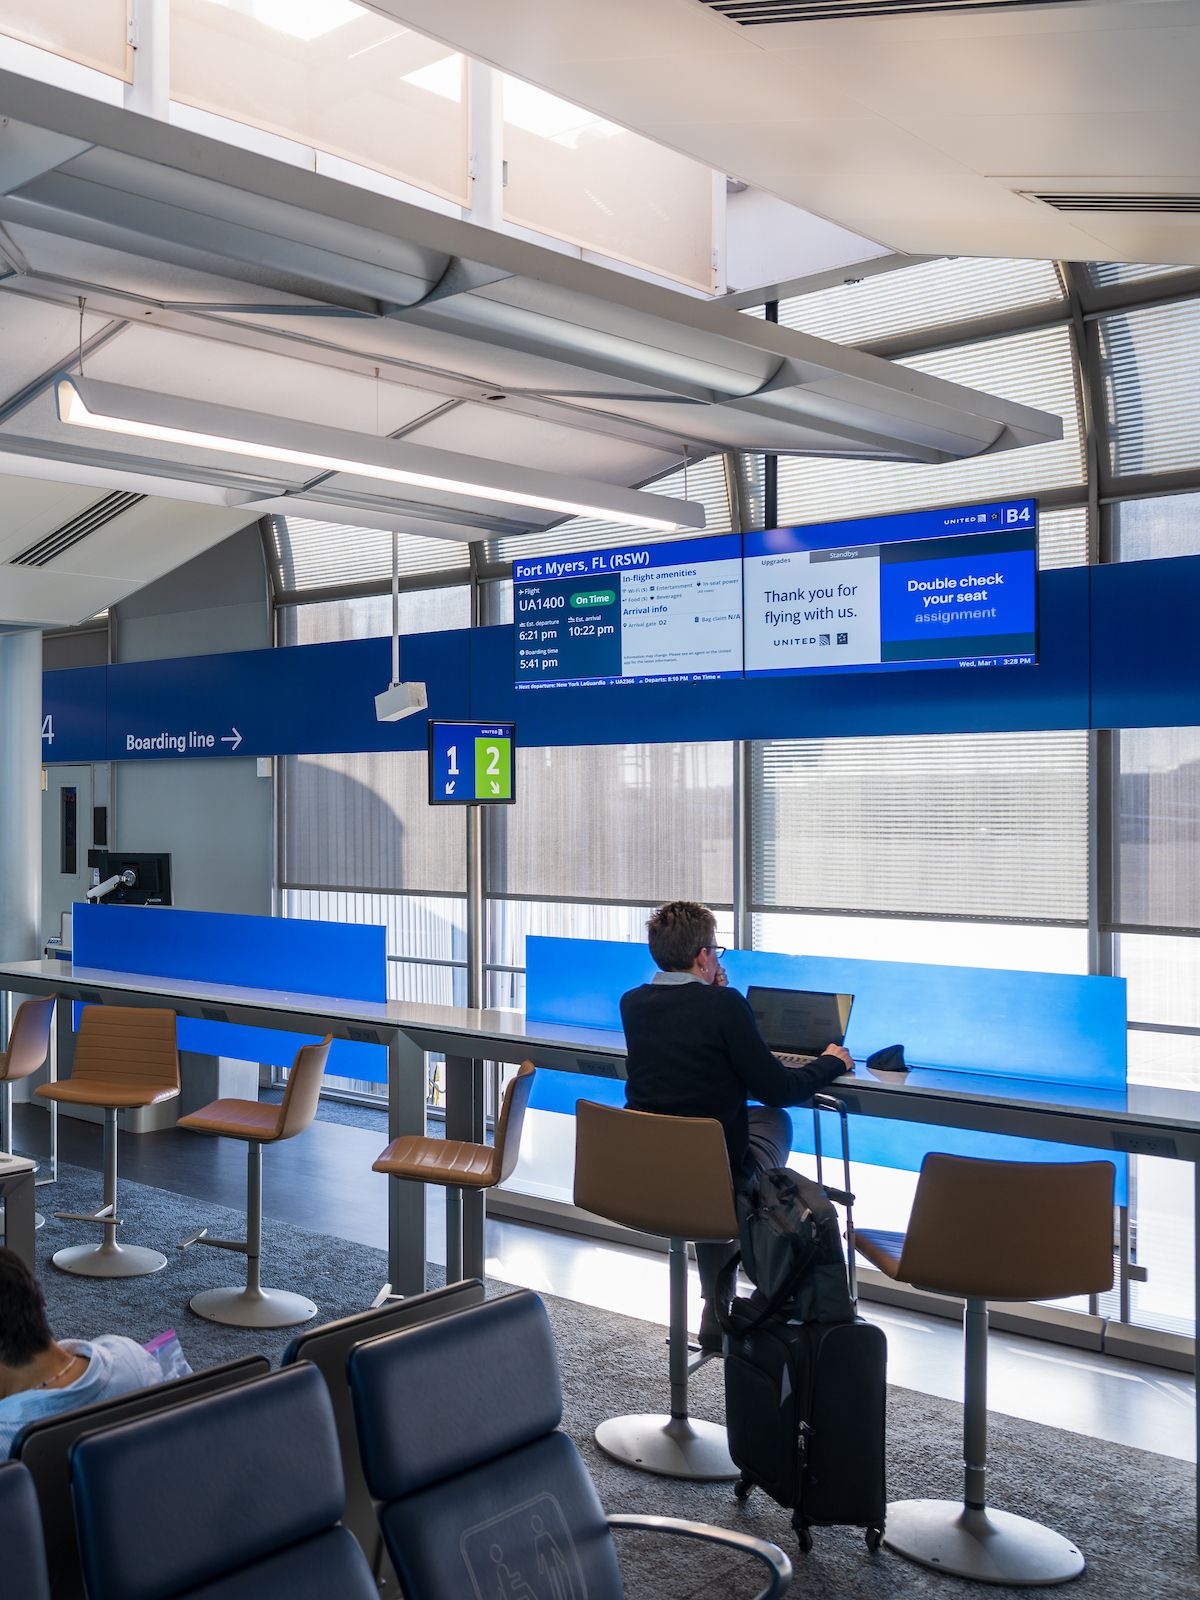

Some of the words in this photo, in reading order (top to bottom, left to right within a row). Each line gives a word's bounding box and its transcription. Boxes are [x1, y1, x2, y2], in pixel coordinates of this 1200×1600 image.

[943, 516, 976, 525] UNITED
[1006, 507, 1030, 523] B4
[829, 550, 859, 559] Standbys
[516, 565, 542, 578] Fort
[545, 560, 588, 577] Myers,
[592, 556, 607, 569] FL
[610, 551, 650, 569] (RSW)
[761, 558, 791, 566] Upgrades
[623, 573, 654, 583] In-flight
[656, 569, 697, 579] amenities
[657, 583, 693, 591] Entertainment
[907, 577, 957, 592] Double
[959, 573, 1004, 588] check
[524, 587, 540, 596] Flight
[764, 587, 805, 603] Thank
[808, 588, 834, 603] you
[837, 583, 858, 597] for
[519, 596, 565, 611] UA1400
[575, 597, 588, 605] On
[589, 594, 610, 603] Time
[922, 592, 954, 608] your
[956, 590, 988, 603] seat
[623, 606, 650, 615] Arrival
[652, 605, 668, 613] info
[915, 607, 997, 624] assignment
[765, 610, 801, 627] flying
[804, 606, 834, 621] with
[838, 607, 857, 618] us.
[535, 619, 560, 627] departure
[519, 630, 538, 641] 6:21
[541, 630, 557, 641] pm
[568, 625, 595, 637] 10:22
[597, 625, 614, 637] pm
[773, 637, 816, 646] UNITED
[520, 658, 539, 669] 5:41
[542, 659, 558, 670] pm
[977, 659, 992, 667] Mar
[1003, 658, 1019, 666] 3:28
[580, 679, 606, 687] LaGuardia
[126, 732, 186, 753] Boarding
[189, 731, 215, 748] line
[447, 745, 460, 775] 1
[486, 746, 500, 775] 2
